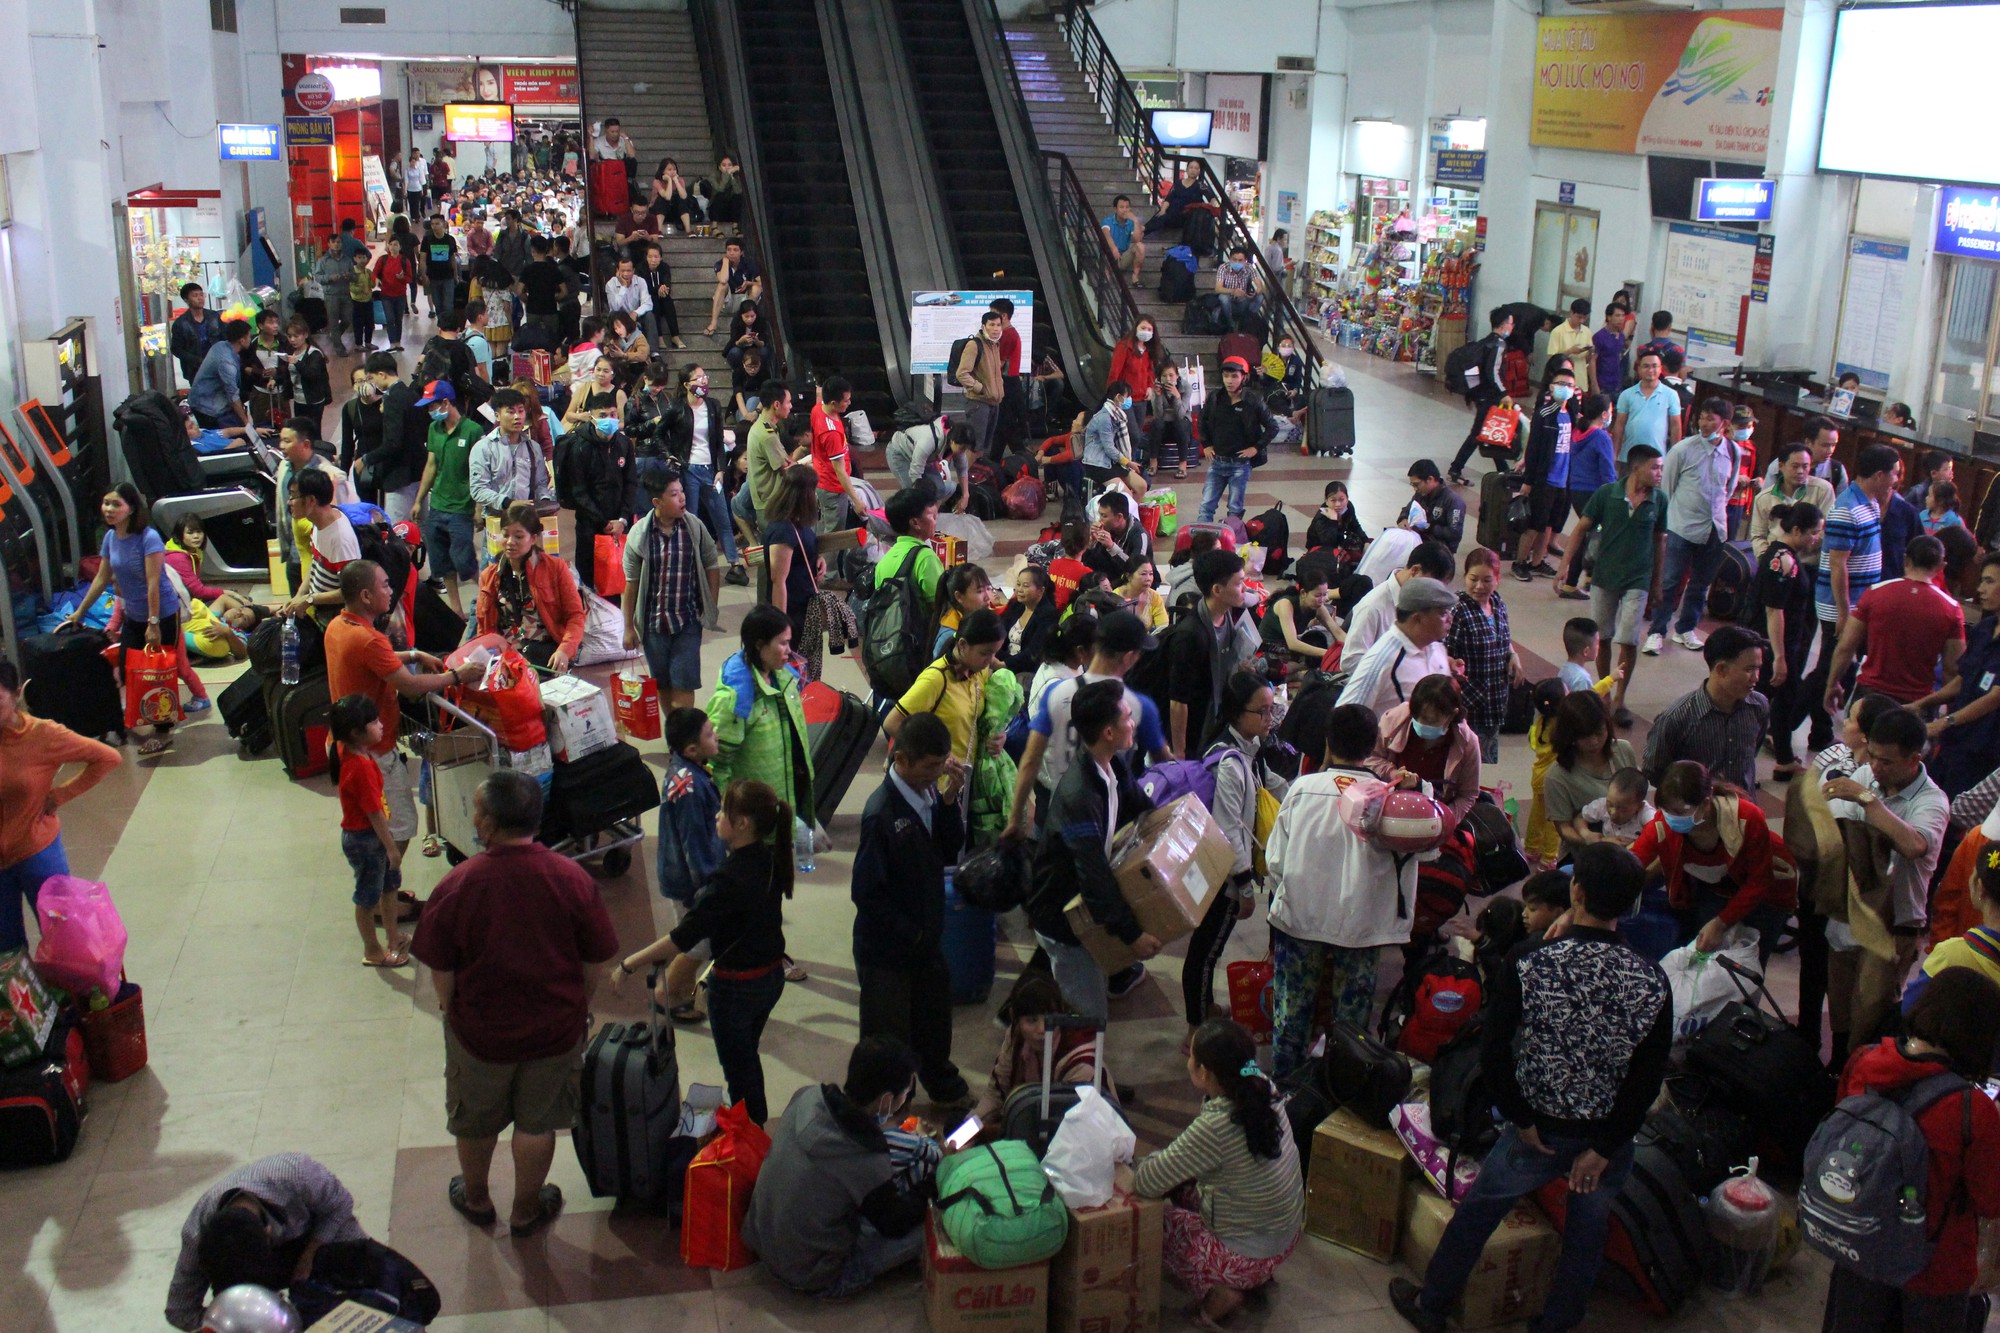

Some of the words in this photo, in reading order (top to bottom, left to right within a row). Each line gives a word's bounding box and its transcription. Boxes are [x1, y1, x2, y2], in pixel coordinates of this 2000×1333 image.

[1540, 63, 1563, 93] MỌI
[1593, 62, 1618, 95] MỌI
[1715, 207, 1756, 216] INFORMATION
[1760, 237, 1772, 248] WC
[1958, 237, 1995, 251] PASSENGER
